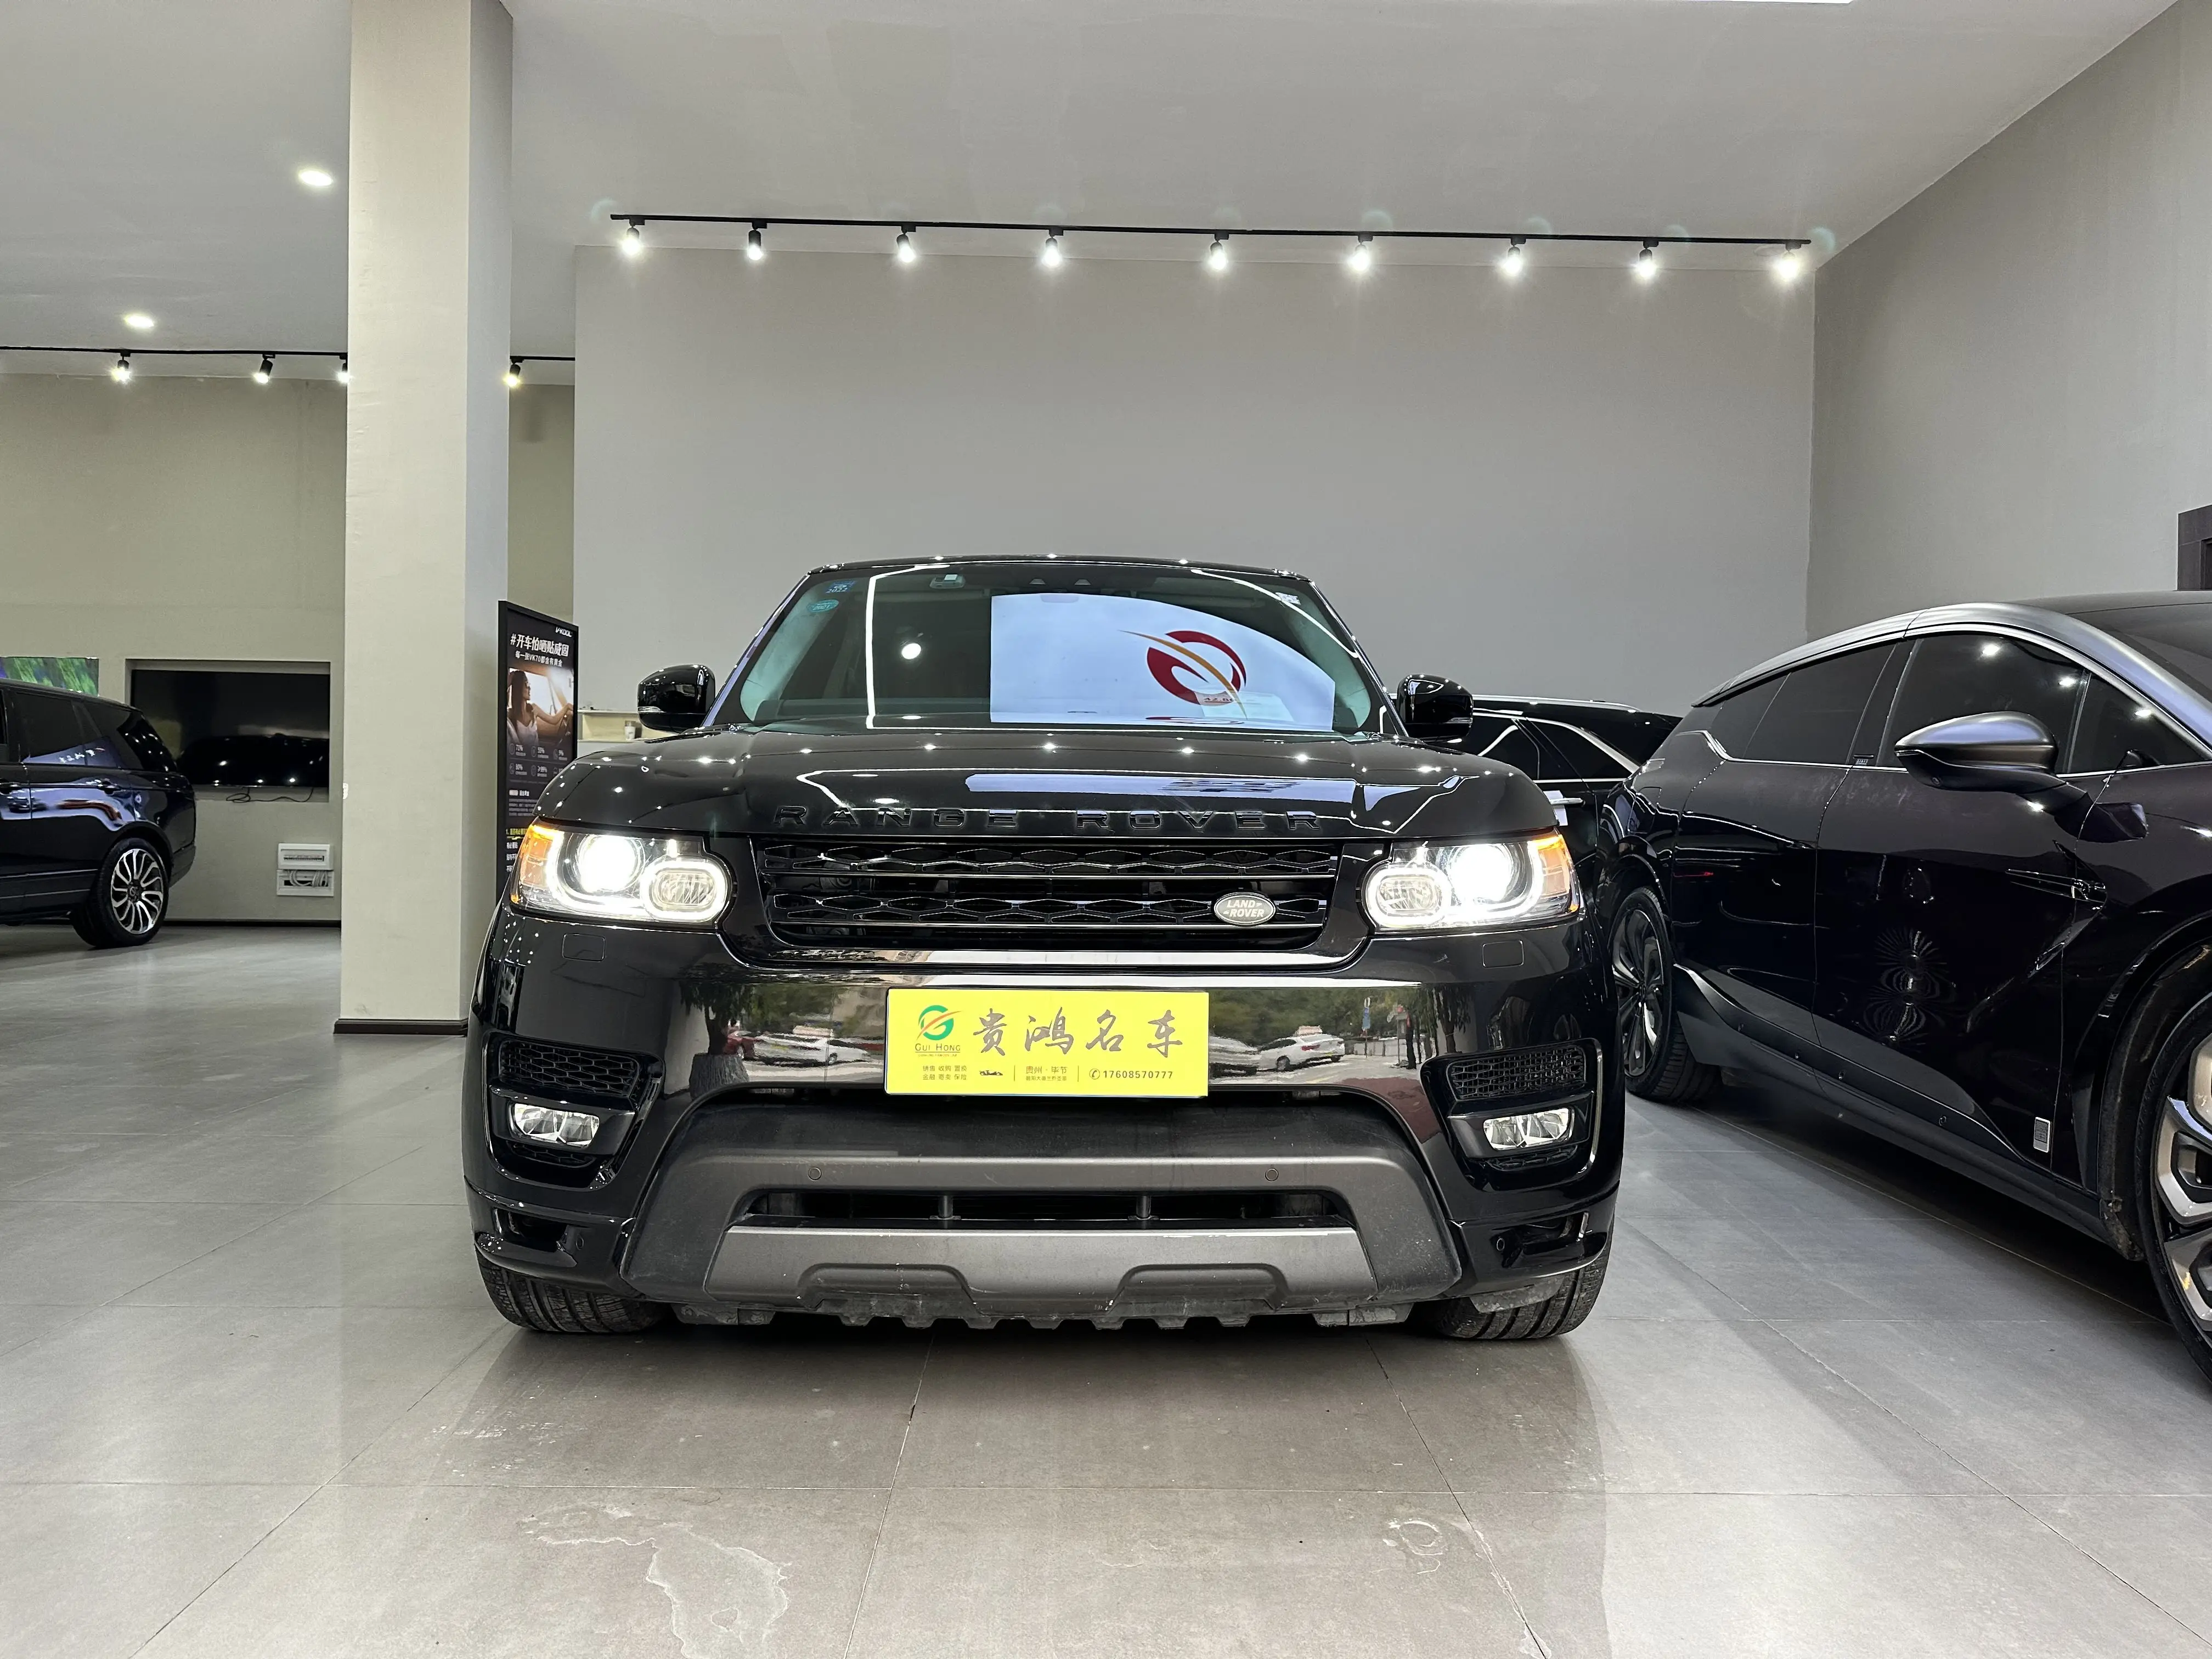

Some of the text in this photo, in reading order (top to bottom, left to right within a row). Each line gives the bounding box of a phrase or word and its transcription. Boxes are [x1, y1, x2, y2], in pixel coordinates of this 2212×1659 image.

[774, 805, 1320, 830] RANGE ROVER
[1226, 900, 1256, 908] LAND
[1229, 909, 1265, 917] ROVER
[973, 1006, 1183, 1058] 贵鸿名车
[1103, 1070, 1173, 1079] 17608570777
